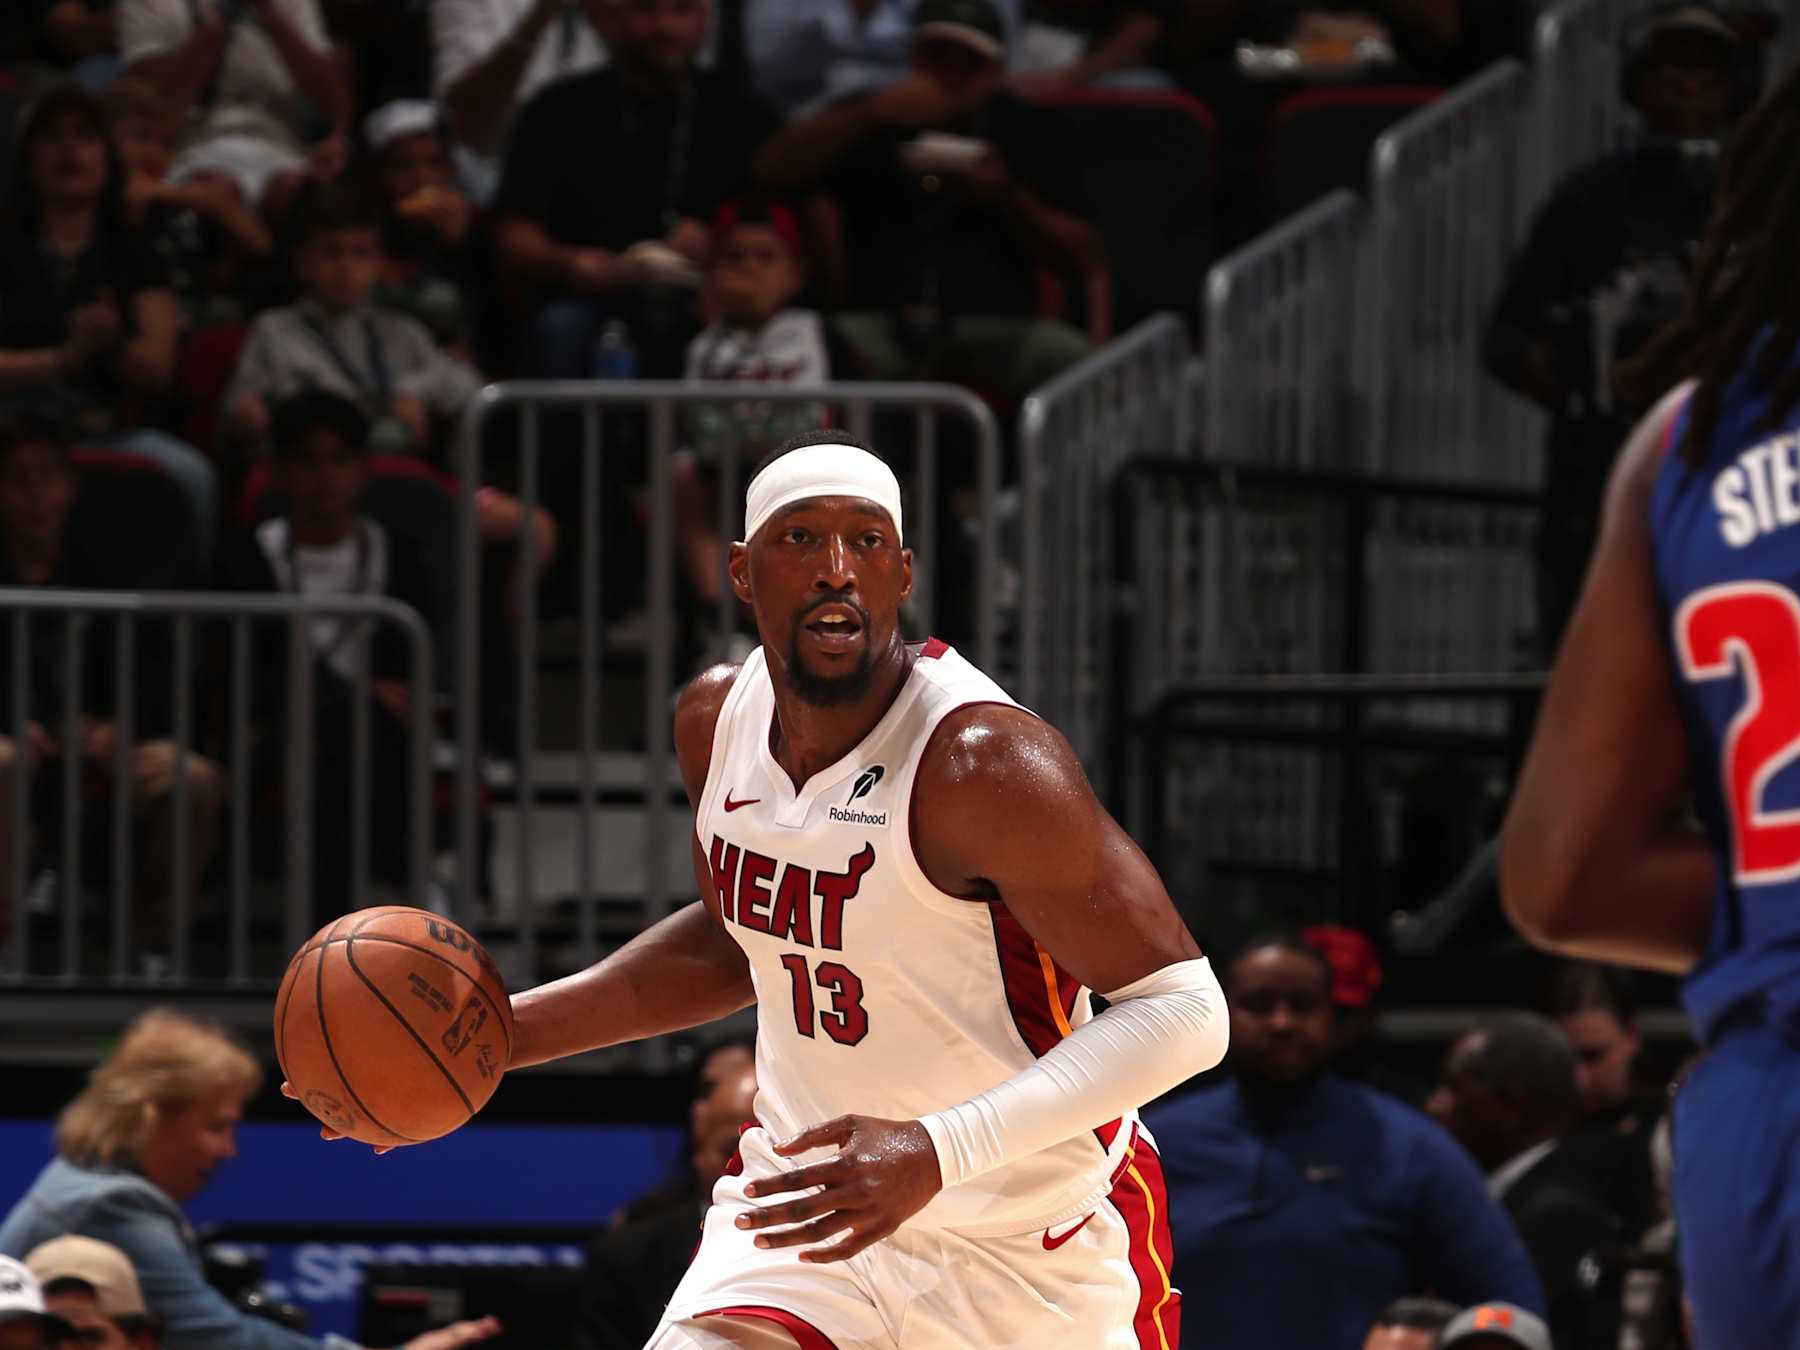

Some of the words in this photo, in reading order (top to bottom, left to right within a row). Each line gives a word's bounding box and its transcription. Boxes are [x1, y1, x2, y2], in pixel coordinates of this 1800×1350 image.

[829, 807, 886, 825] Robinhood
[709, 833, 876, 951] HEAT
[779, 953, 869, 1047] 13
